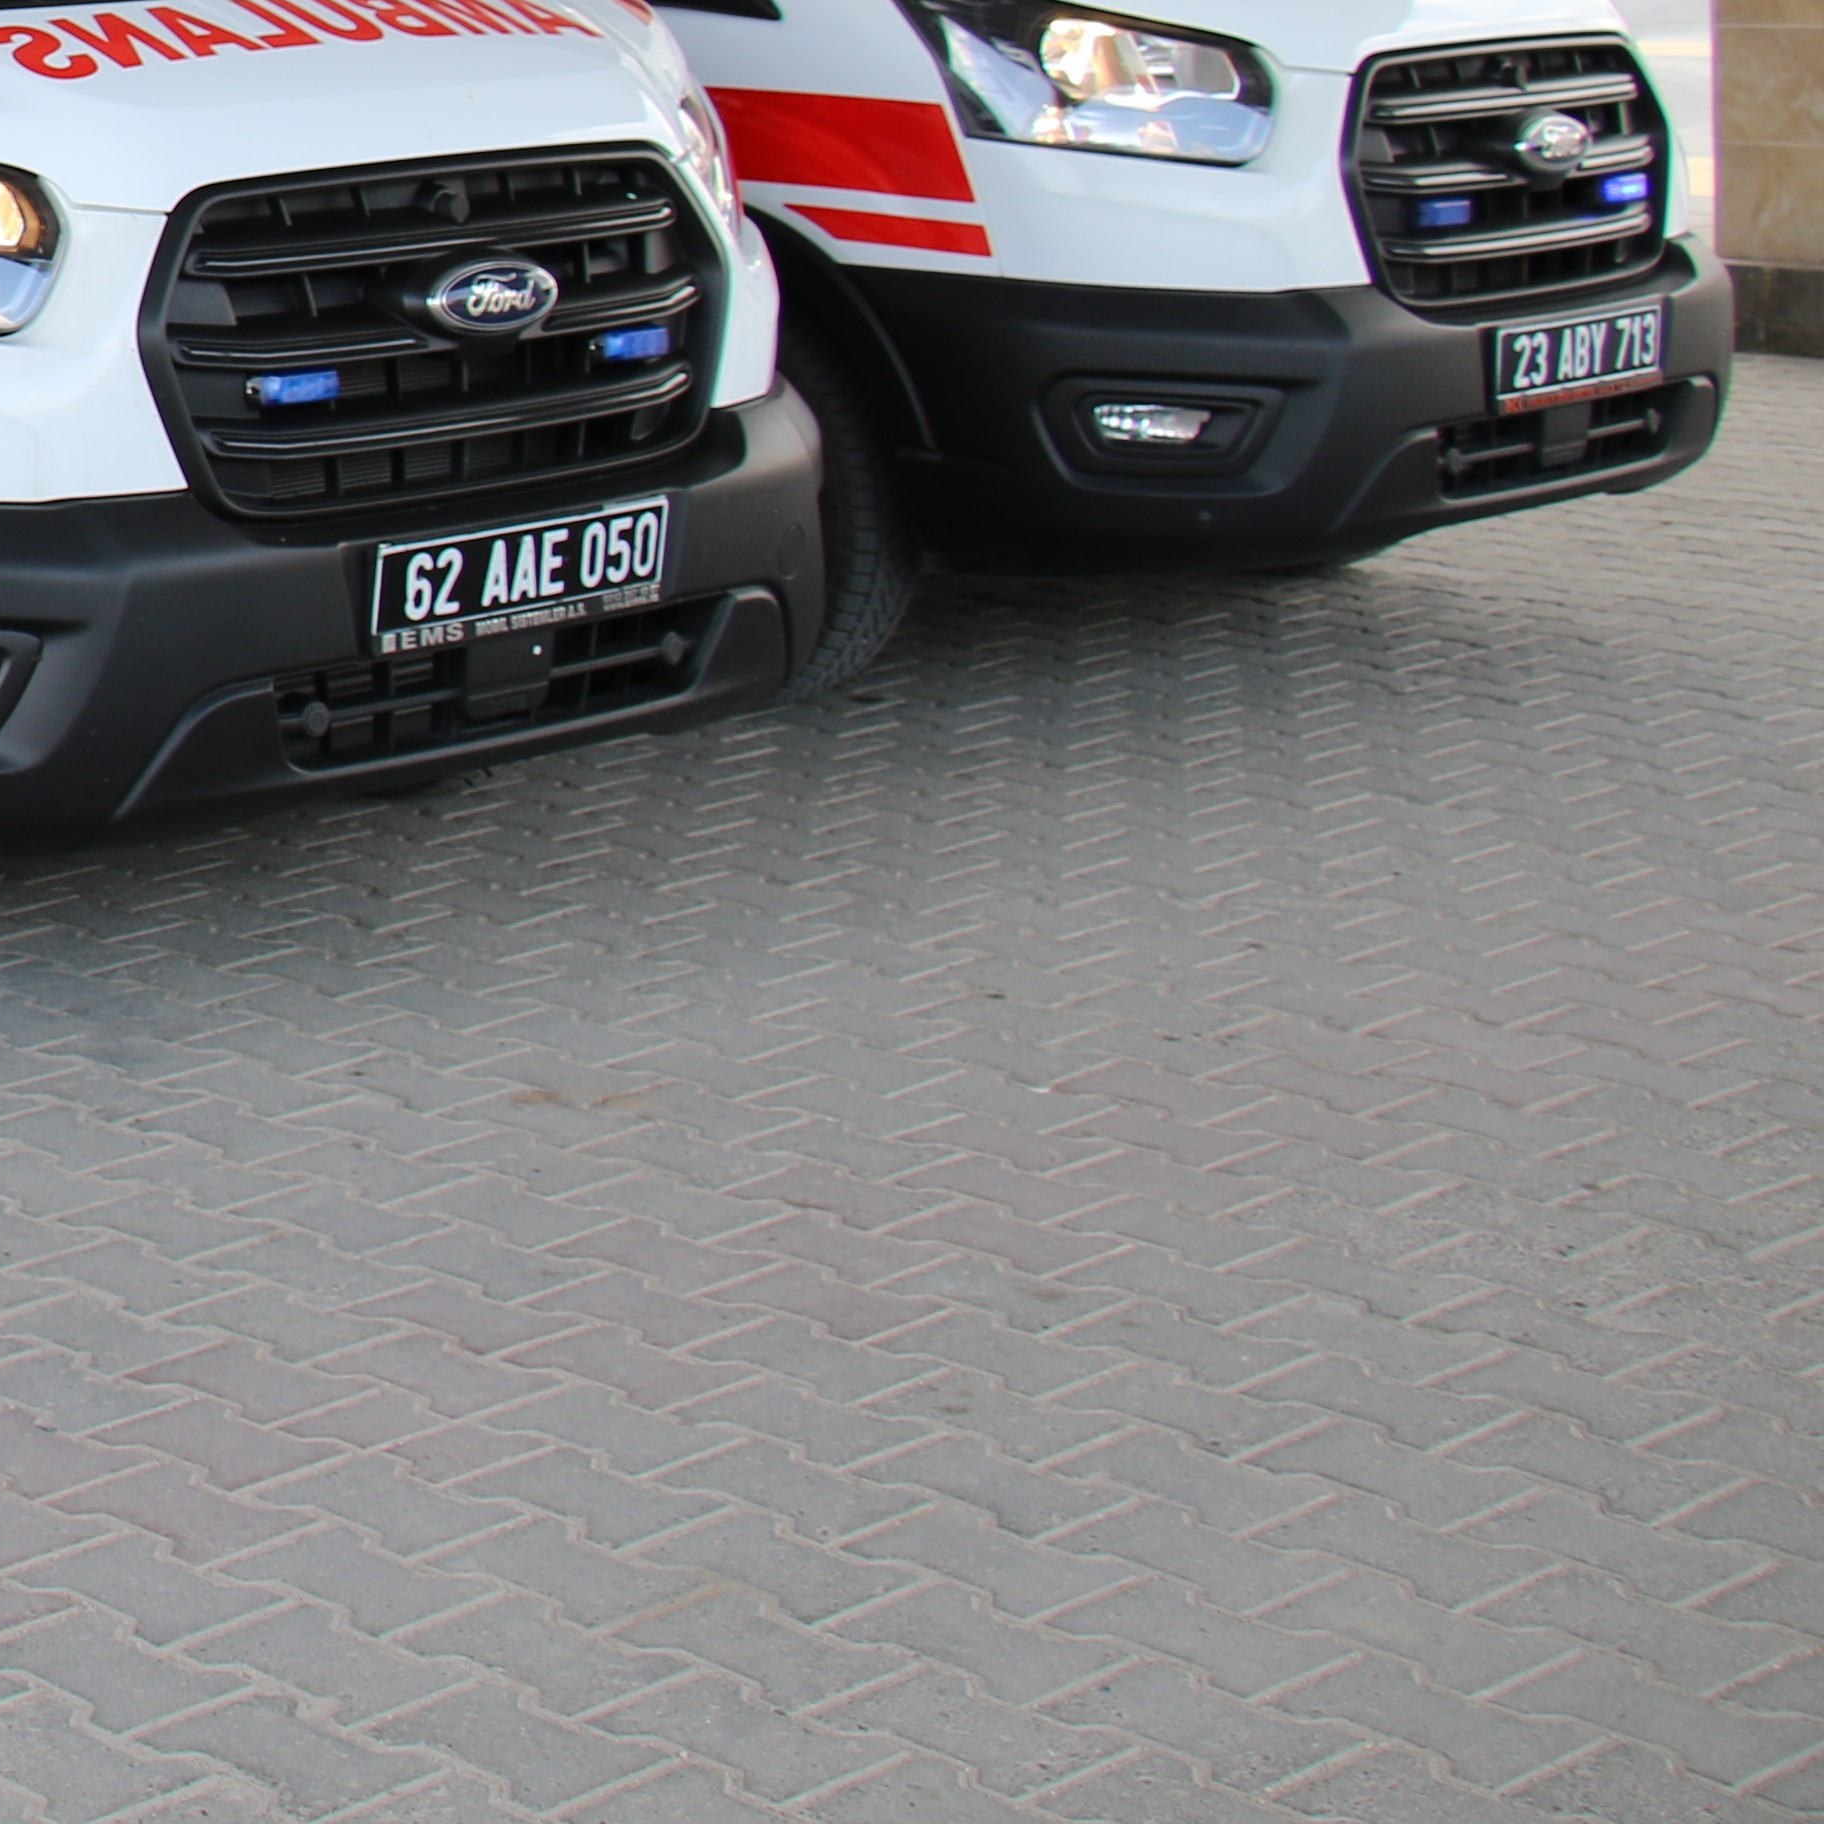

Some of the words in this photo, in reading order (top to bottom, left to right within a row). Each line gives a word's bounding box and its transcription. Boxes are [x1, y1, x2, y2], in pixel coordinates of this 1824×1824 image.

[465, 269, 537, 318] Ford
[1512, 331, 1550, 389] 23
[1614, 312, 1656, 371] 713
[404, 547, 464, 622] 62
[480, 528, 569, 607] AAE
[579, 511, 660, 589] 050
[400, 622, 464, 650] EMS
